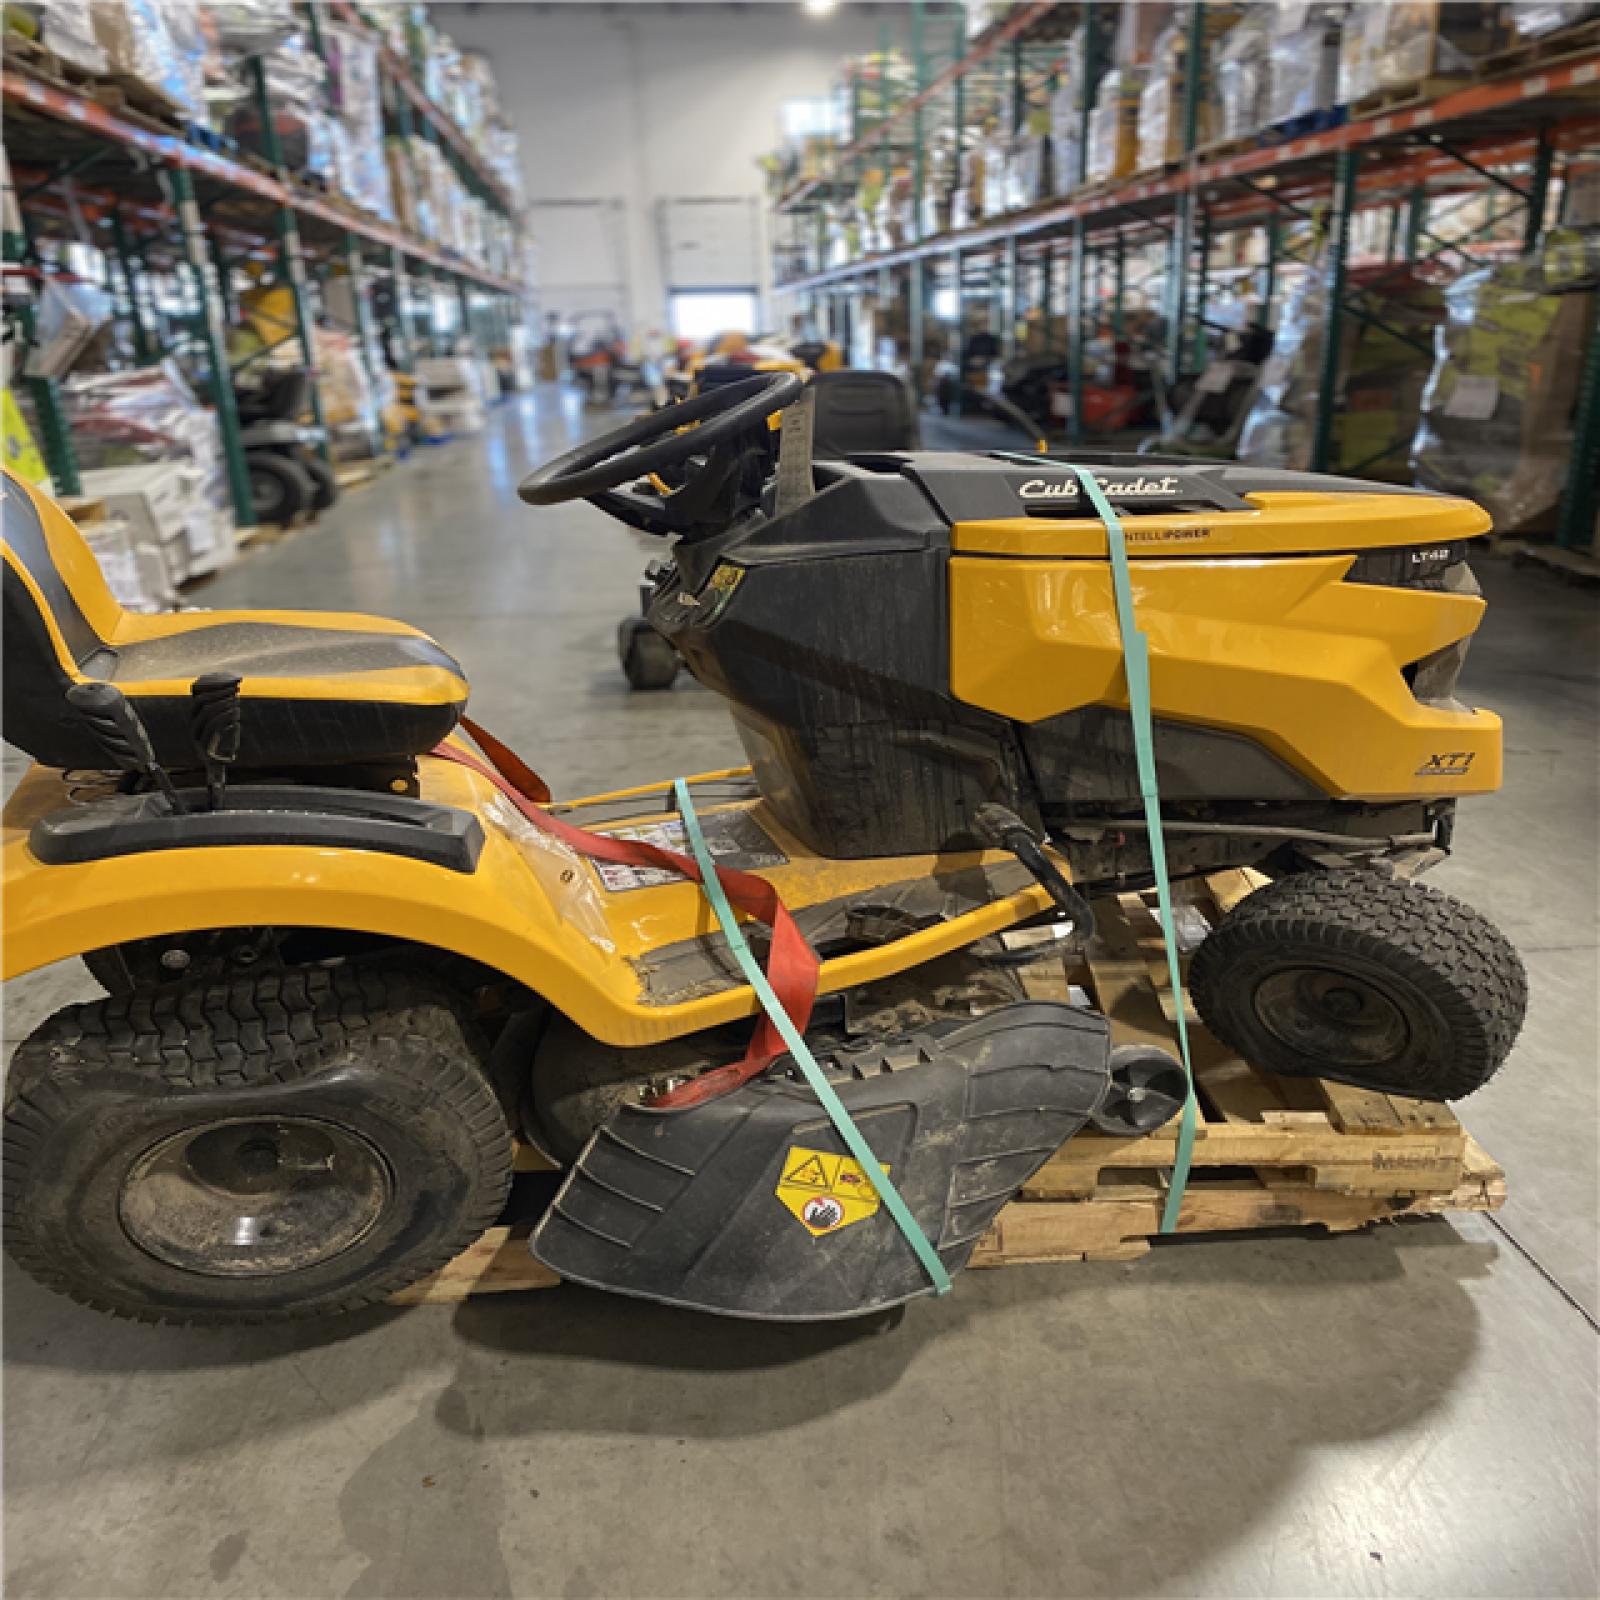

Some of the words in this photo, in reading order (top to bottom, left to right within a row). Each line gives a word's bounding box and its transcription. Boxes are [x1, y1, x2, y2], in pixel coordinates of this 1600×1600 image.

[1019, 479, 1078, 499] Cub
[1124, 527, 1211, 542] NTELLIPOWER
[1424, 752, 1476, 769] XT1
